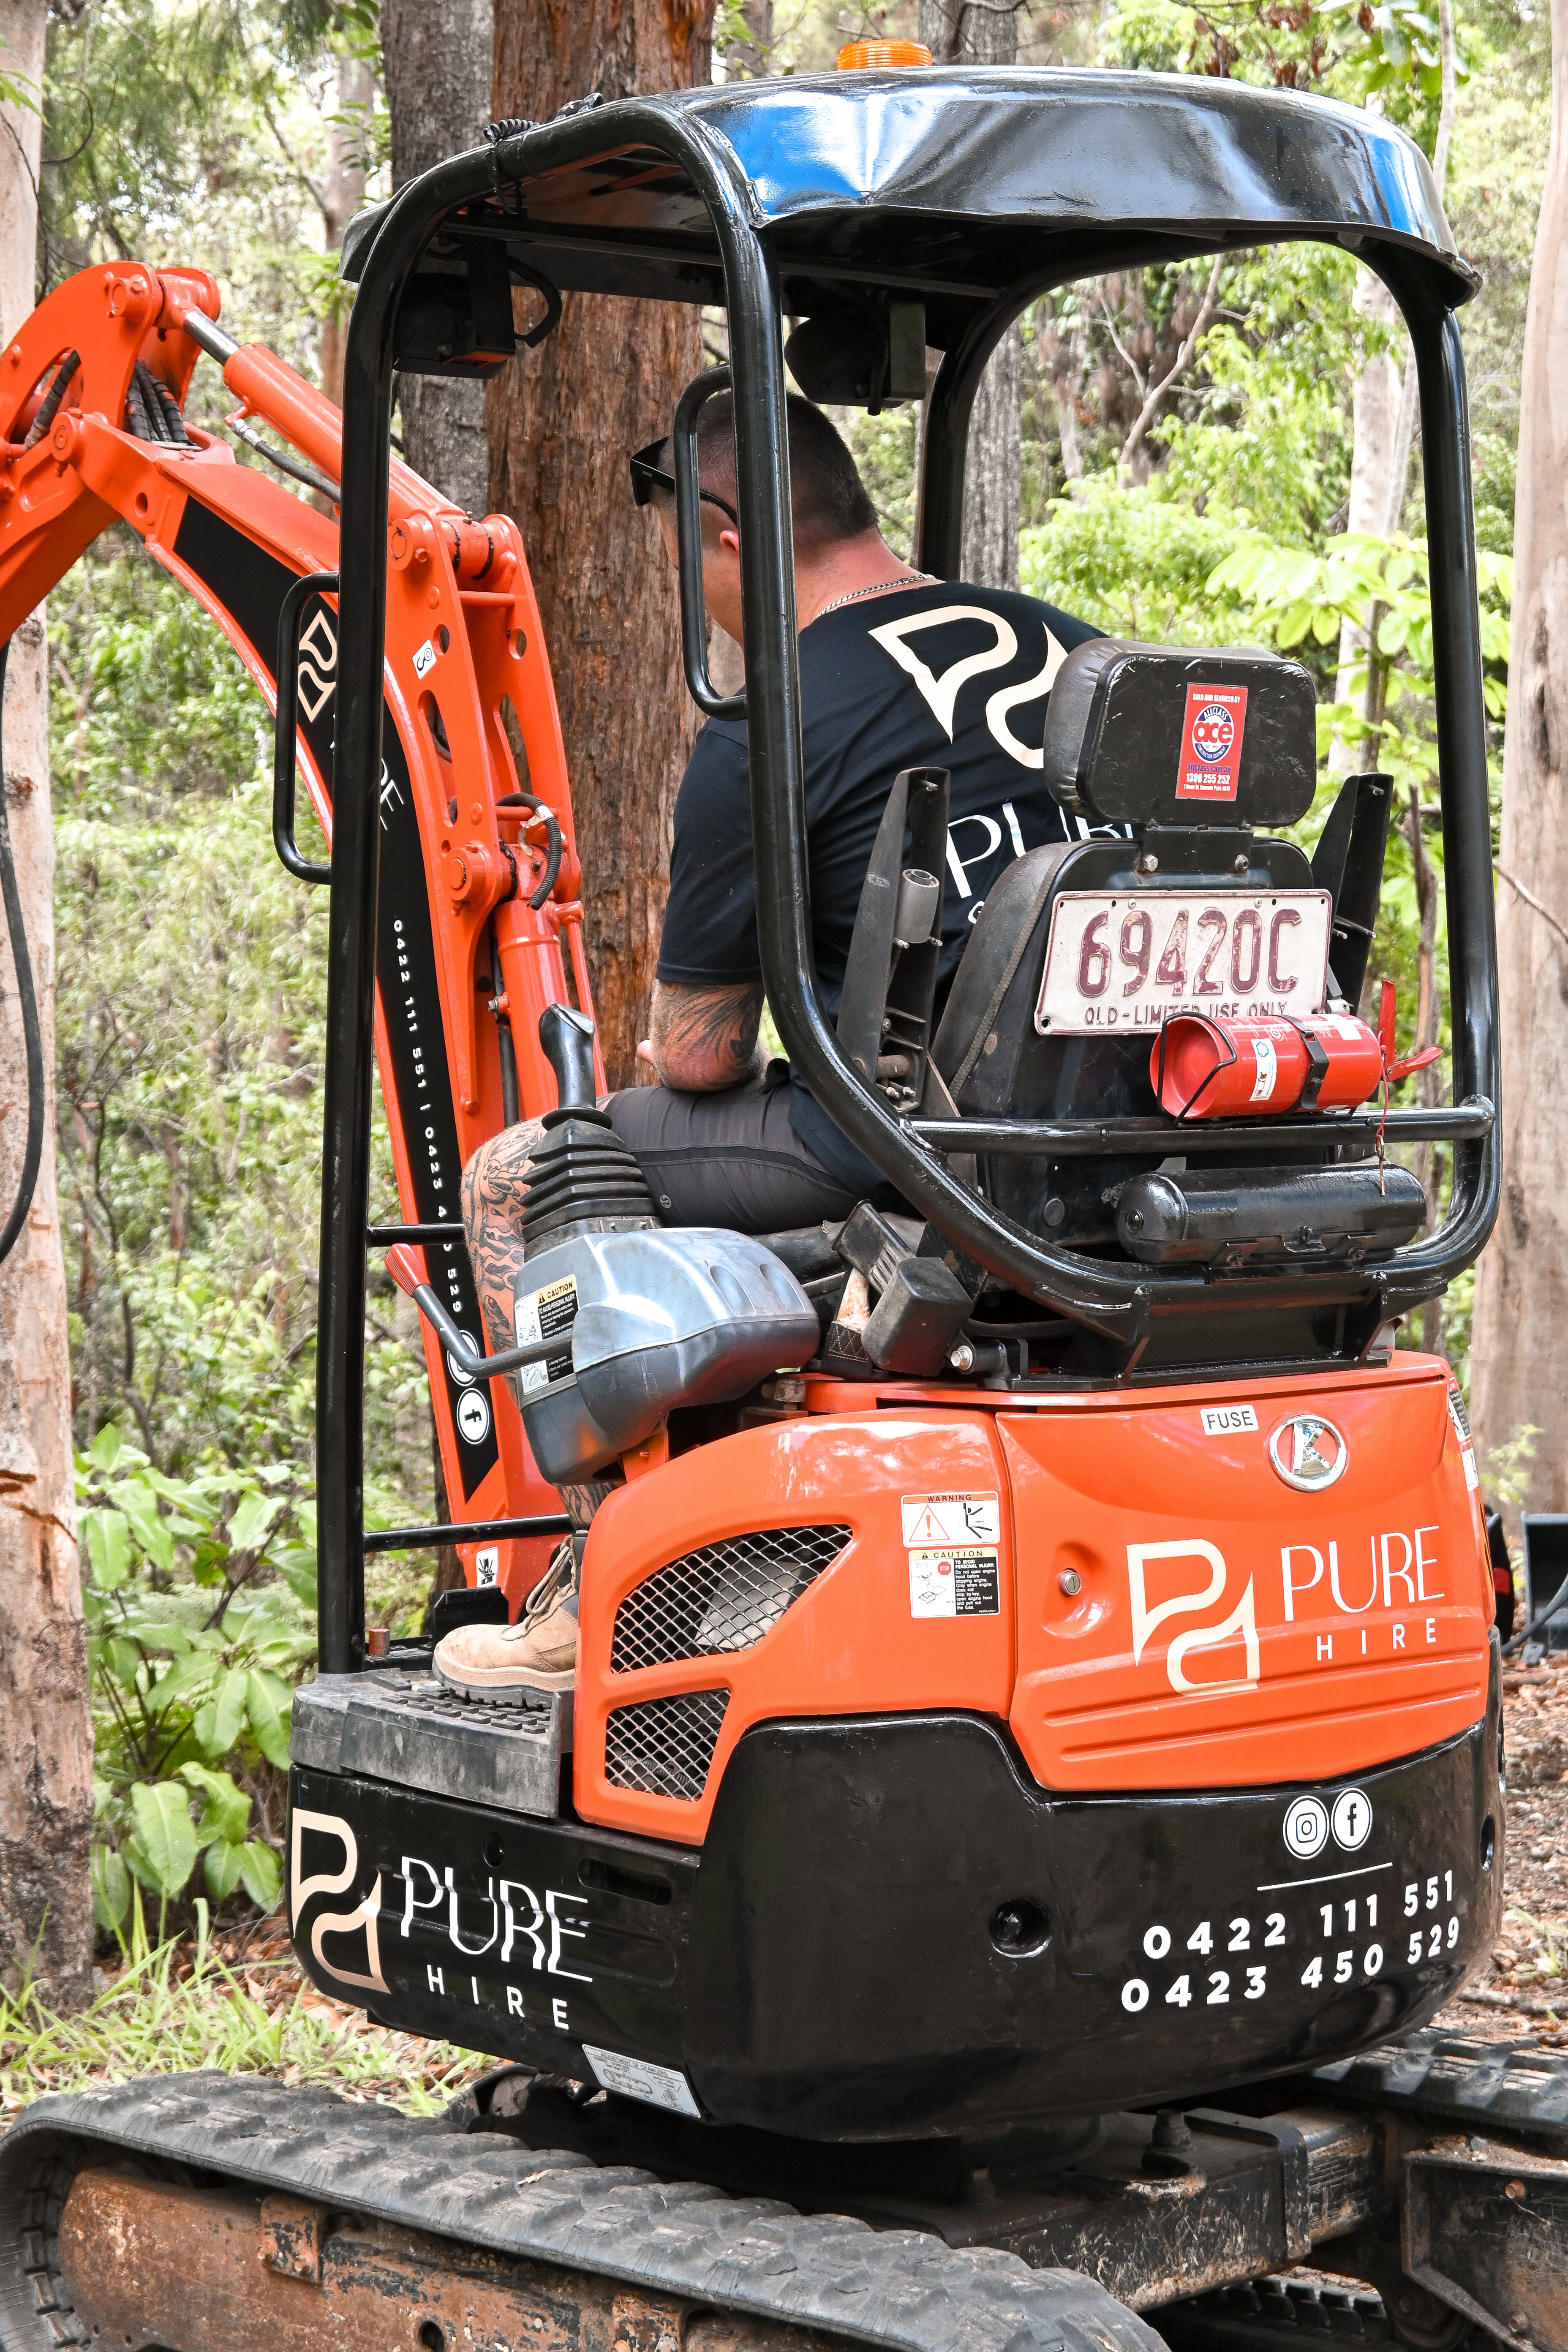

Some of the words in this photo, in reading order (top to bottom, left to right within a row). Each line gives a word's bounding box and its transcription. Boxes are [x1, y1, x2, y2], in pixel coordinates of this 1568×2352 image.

[1203, 707, 1228, 721] ALLCLASS
[1193, 721, 1233, 743] ace
[1186, 773, 1202, 783] 1300
[1203, 773, 1217, 784] 255
[1217, 774, 1230, 784] 252
[1187, 764, 1230, 773] allclass.com.au
[1076, 907, 1301, 997] 69420C
[1209, 1002, 1239, 1017] USE
[1249, 1001, 1287, 1016] ONLY
[394, 919, 410, 982] 0422
[405, 996, 418, 1032] 111
[413, 1043, 426, 1088] 551
[425, 1127, 442, 1189] 0423
[448, 1268, 461, 1312] 529
[547, 1281, 572, 1298] CAUTION
[1207, 1411, 1253, 1429] FUSE
[1281, 1525, 1445, 1622] PURE
[1317, 1617, 1436, 1661] HIRE
[401, 1856, 593, 1982] PURE
[1143, 1912, 1286, 1959] 0422
[1320, 1894, 1378, 1937] 111
[1403, 1869, 1453, 1917] 551
[1121, 1965, 1267, 2012] 0423
[1301, 1943, 1383, 1988] 450
[1407, 1916, 1459, 1965] 529
[427, 1964, 569, 2030] HIRE
[601, 2052, 631, 2066] ADJUSTMENT
[641, 2064, 668, 2077] CRAWLERS
